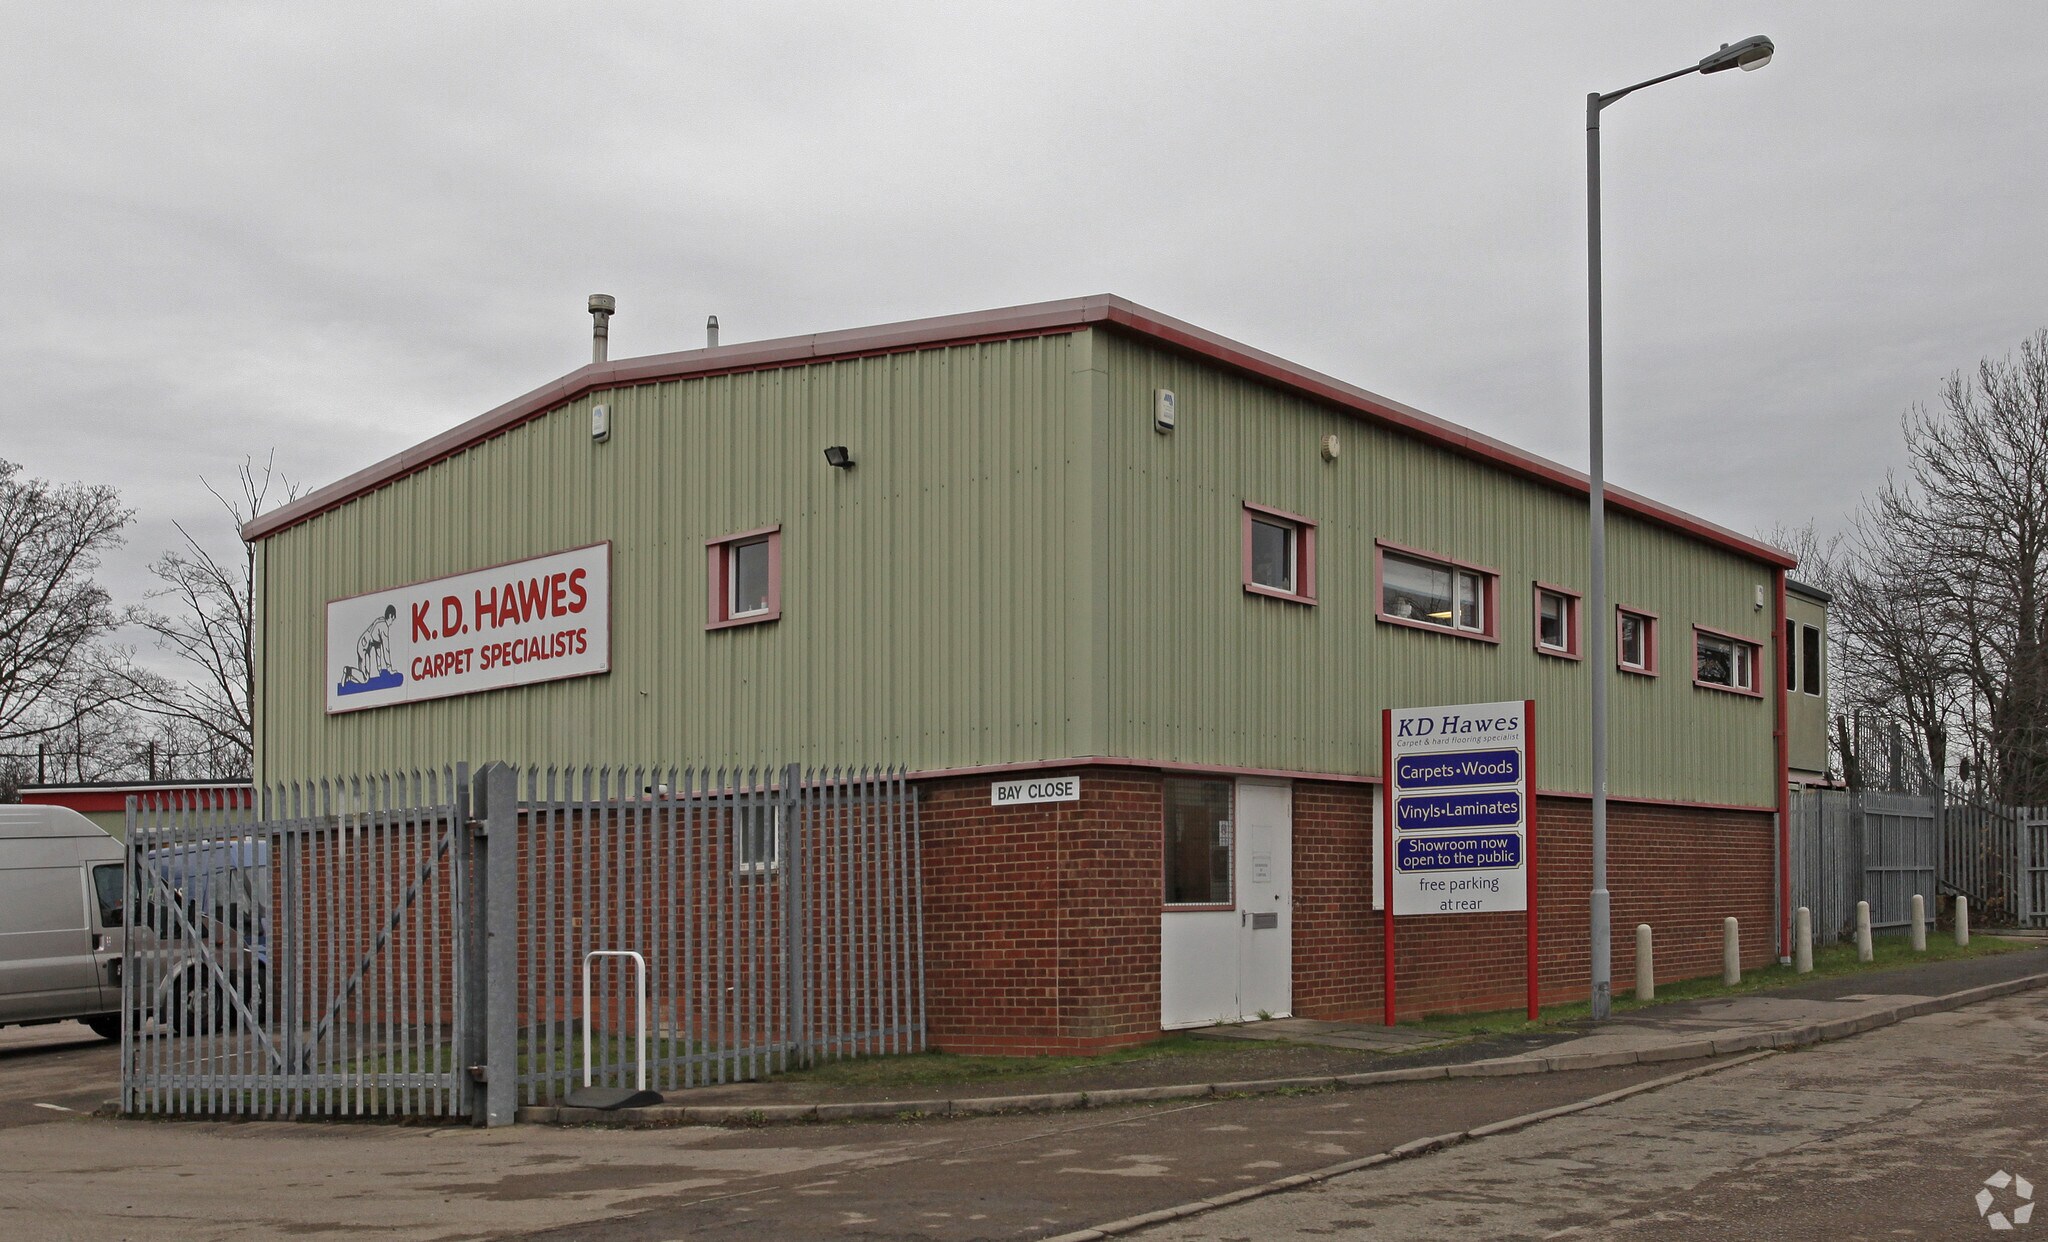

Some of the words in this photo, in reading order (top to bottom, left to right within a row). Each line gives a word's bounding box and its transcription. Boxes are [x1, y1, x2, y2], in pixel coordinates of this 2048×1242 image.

[412, 596, 468, 643] K.D.
[475, 568, 588, 631] HAWES
[411, 648, 474, 681] CARPET
[480, 628, 588, 670] SPECIALISTS
[1397, 717, 1435, 737] KD
[1440, 715, 1519, 734] Hawes
[1396, 739, 1422, 748] Carpet
[1432, 736, 1450, 745] hard
[1452, 735, 1482, 744] flooring
[1483, 733, 1519, 743] specialist
[1462, 760, 1513, 775] Woods
[998, 785, 1022, 800] BAY
[1028, 782, 1073, 798] CLOSE
[1409, 839, 1477, 852] Showroom
[1481, 838, 1508, 849] now
[1403, 856, 1434, 869] open
[1438, 853, 1450, 864] to
[1454, 852, 1474, 864] the
[1477, 850, 1515, 866] public
[1419, 878, 1446, 891] free
[1450, 876, 1500, 893] parking
[1440, 899, 1453, 910] at
[1456, 899, 1483, 910] rear
